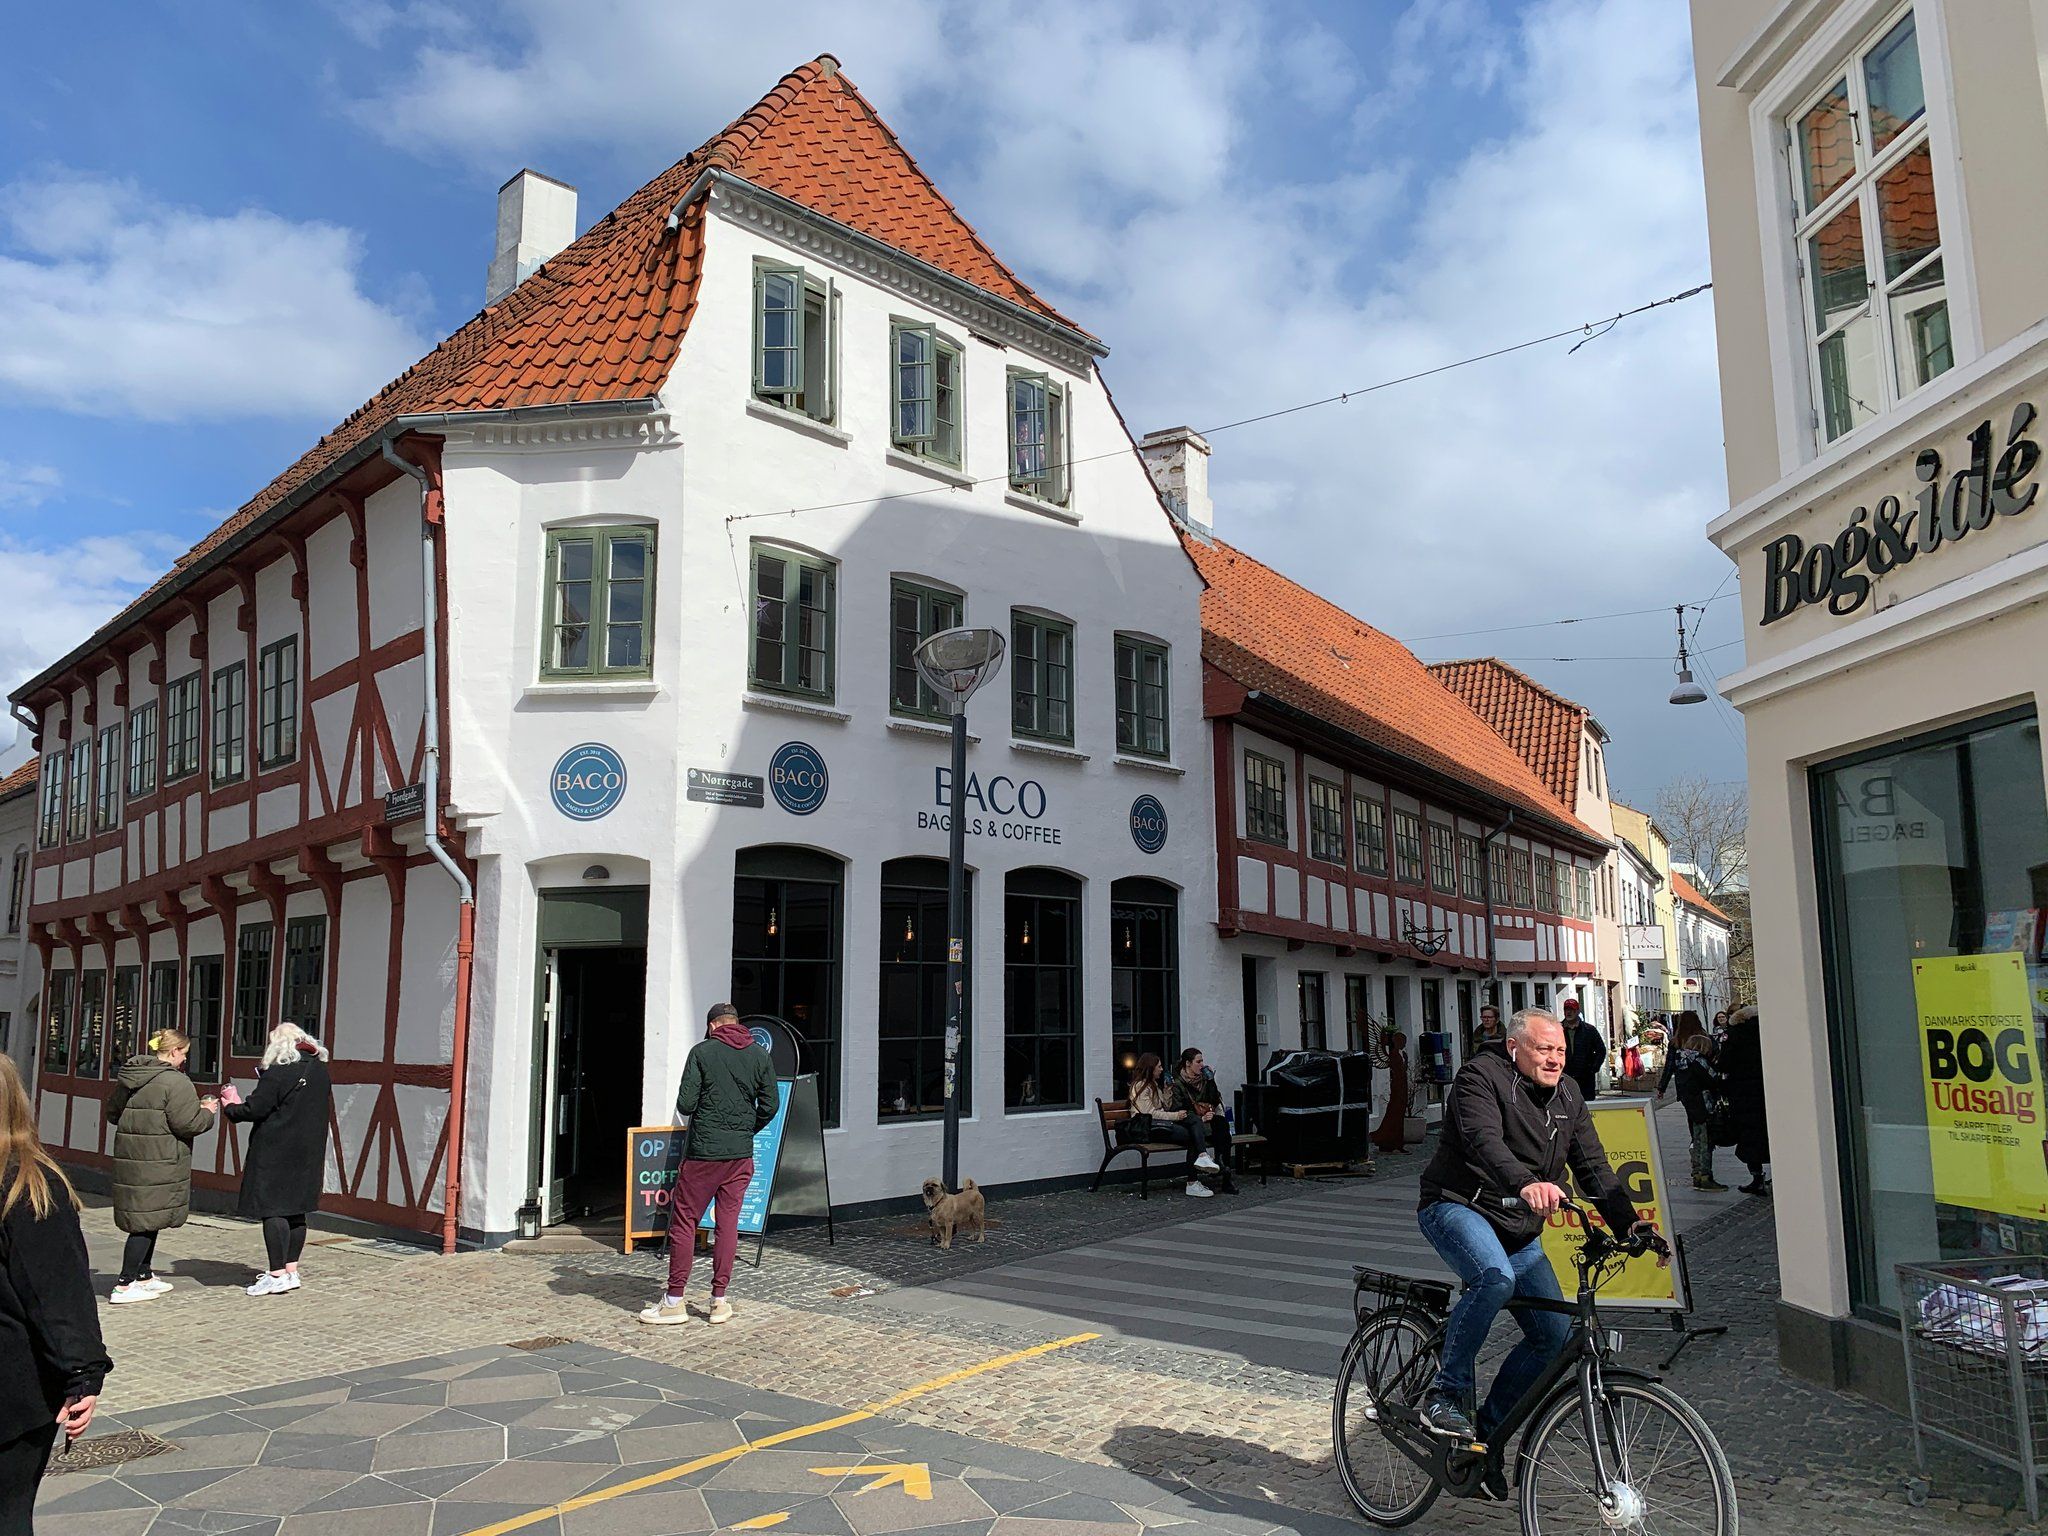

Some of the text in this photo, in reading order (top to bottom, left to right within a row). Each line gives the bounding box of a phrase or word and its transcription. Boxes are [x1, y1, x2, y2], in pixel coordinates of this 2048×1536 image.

[556, 771, 621, 791] BACO
[701, 772, 754, 790] Nørregade
[774, 767, 824, 789] BACO
[935, 766, 1047, 819] BACO
[917, 811, 1062, 845] BAGLS & COFFEE
[1133, 815, 1165, 832] BACO
[1925, 1014, 2023, 1027] DANMARKS STØRSTE
[1926, 1028, 2033, 1085] BOG
[1931, 1081, 2036, 1124] Udsalg
[1604, 1150, 1647, 1160] TØRSTE
